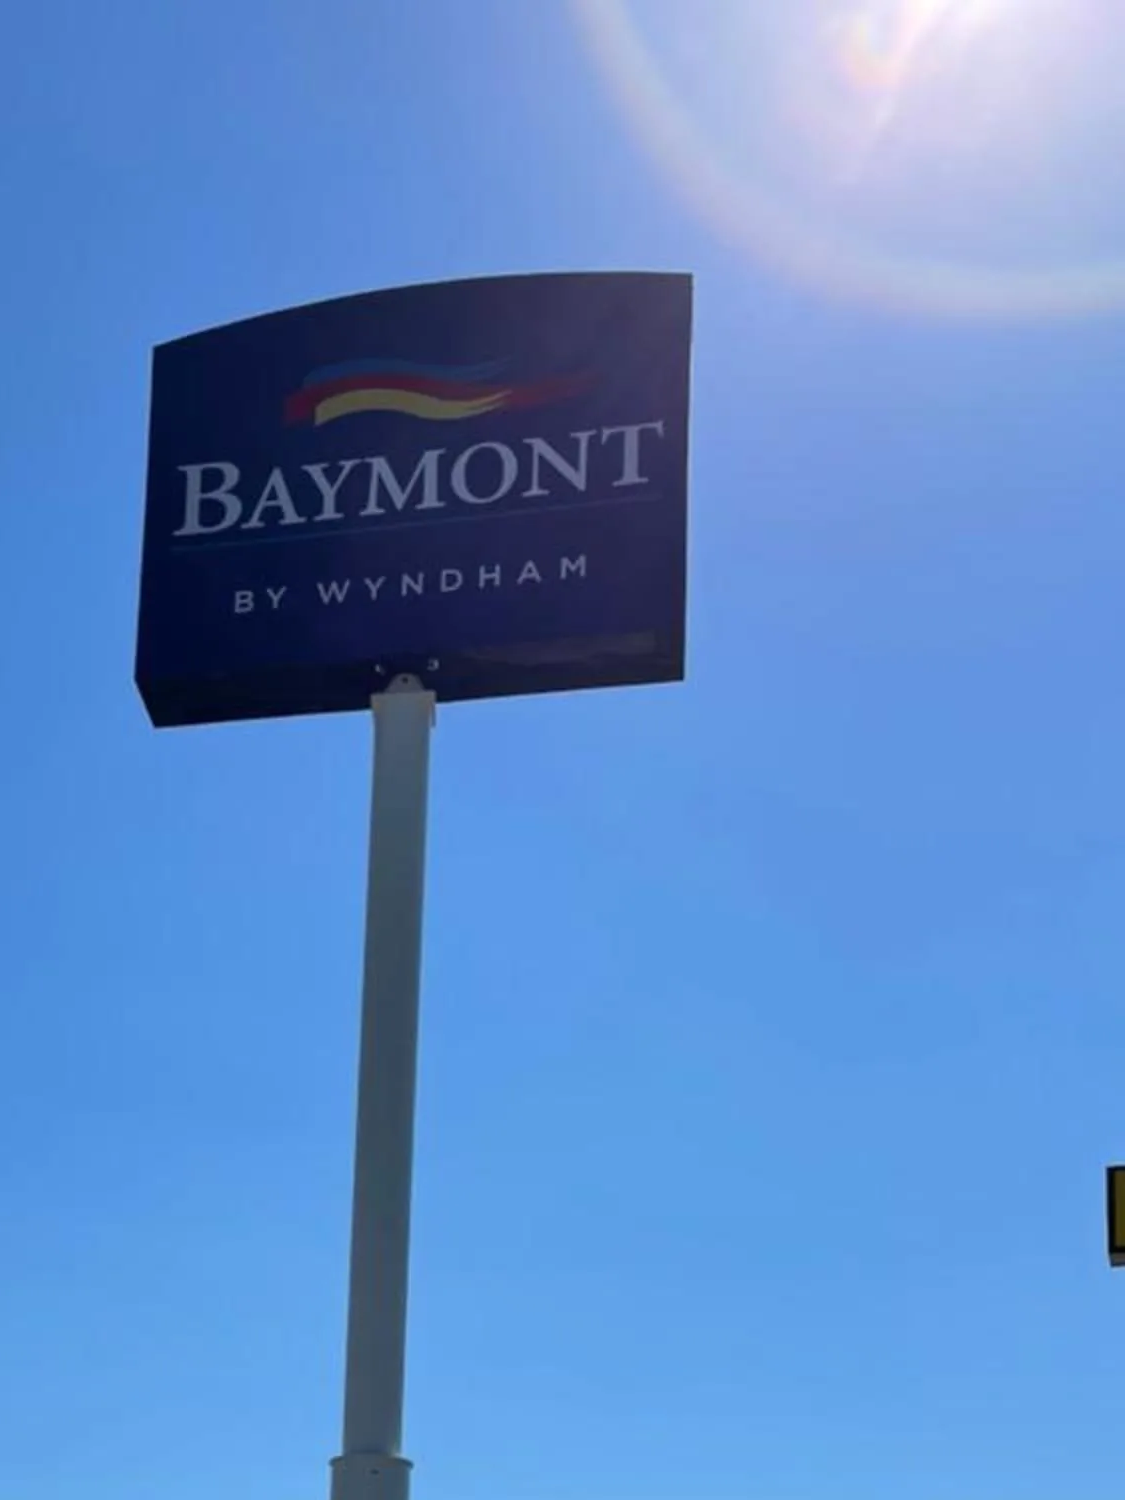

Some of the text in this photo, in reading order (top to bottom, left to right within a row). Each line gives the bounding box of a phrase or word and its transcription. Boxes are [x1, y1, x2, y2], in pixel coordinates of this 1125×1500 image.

[172, 420, 665, 536] BAYMONT
[234, 554, 586, 613] BY WYNDHAM
